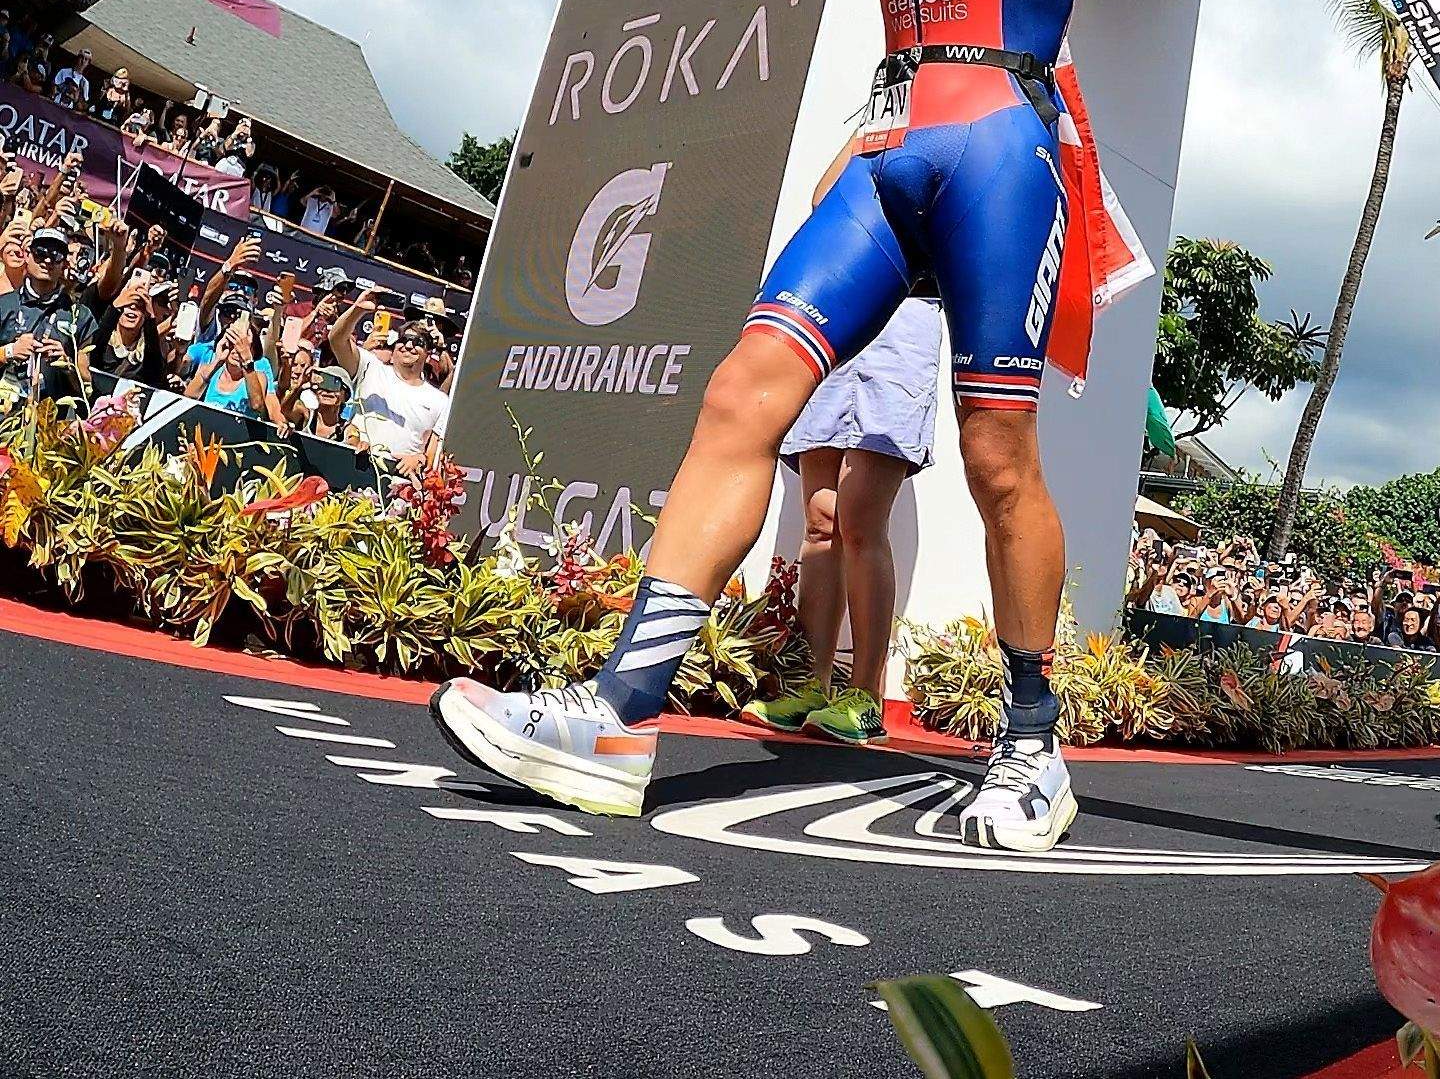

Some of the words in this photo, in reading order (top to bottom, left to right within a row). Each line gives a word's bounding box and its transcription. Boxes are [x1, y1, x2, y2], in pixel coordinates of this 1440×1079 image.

[0, 103, 89, 155] QATAR
[1025, 194, 1066, 348] GIANT
[499, 343, 692, 396] ENDURANCE
